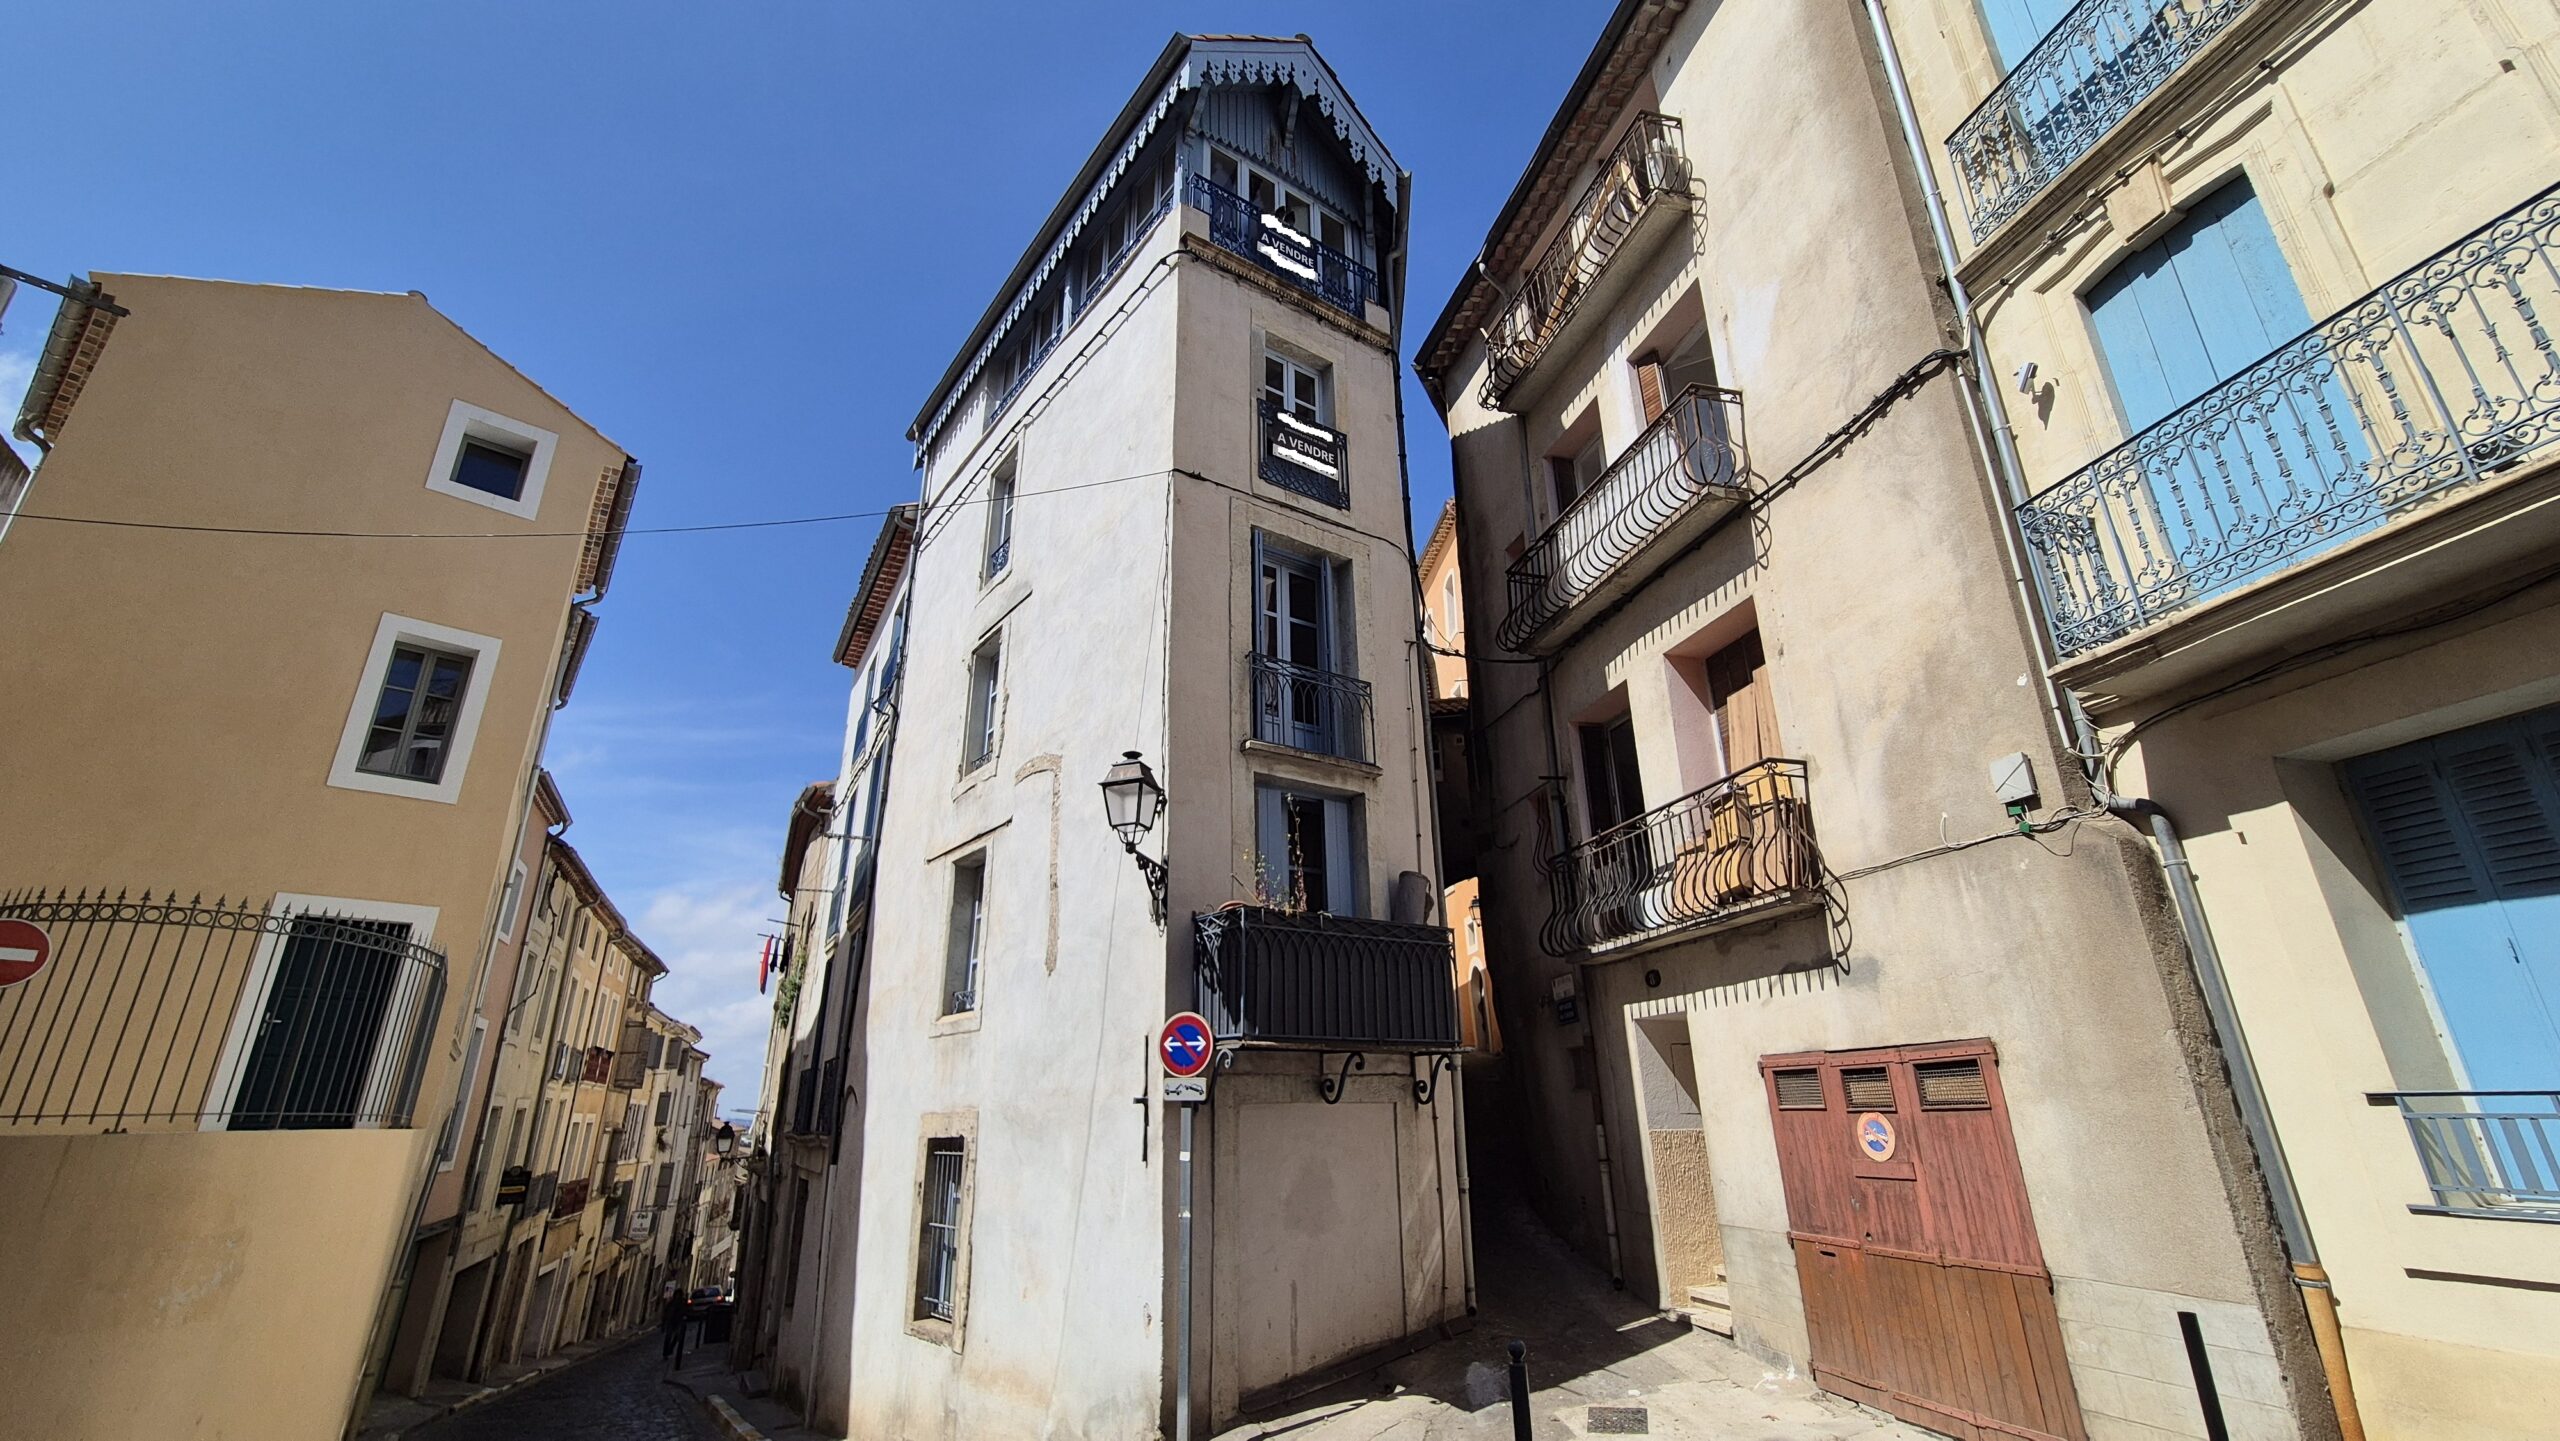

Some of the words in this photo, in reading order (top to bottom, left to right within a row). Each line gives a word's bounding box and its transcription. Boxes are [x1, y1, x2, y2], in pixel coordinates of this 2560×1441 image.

[1261, 233, 1270, 244] A
[1271, 237, 1314, 268] VENDRE
[1277, 432, 1287, 444] A
[1289, 435, 1335, 465] VENDRE
